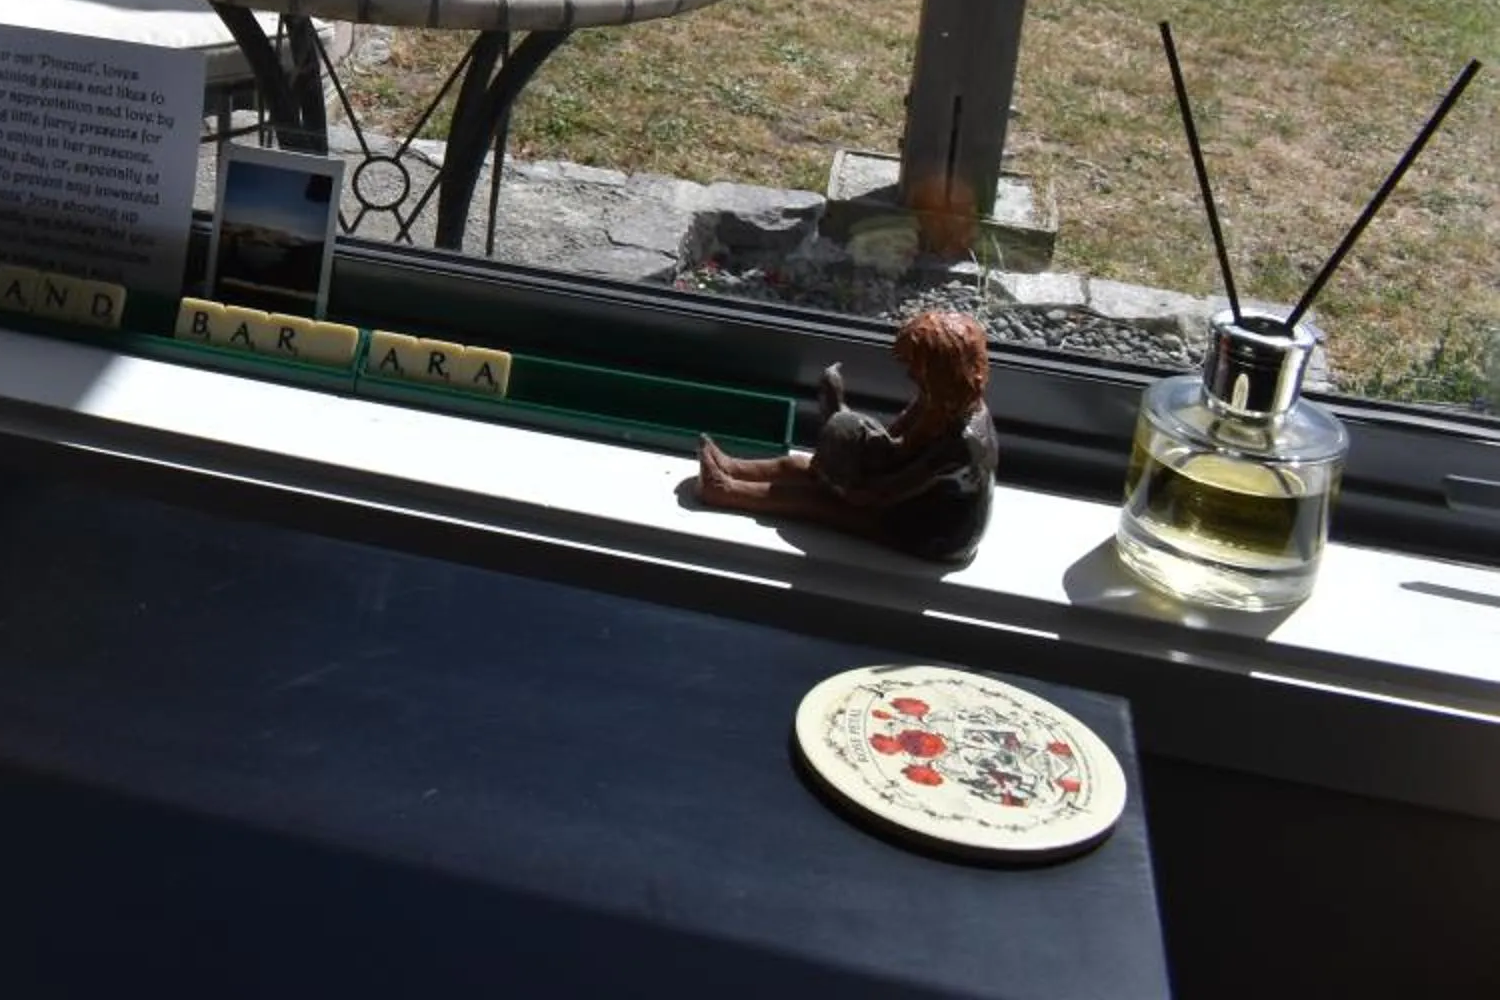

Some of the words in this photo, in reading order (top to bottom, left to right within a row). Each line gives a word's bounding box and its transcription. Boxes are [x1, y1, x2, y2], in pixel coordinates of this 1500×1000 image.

[151, 90, 164, 104] to
[157, 112, 175, 129] by
[141, 127, 162, 145] for
[5, 279, 114, 327] AND
